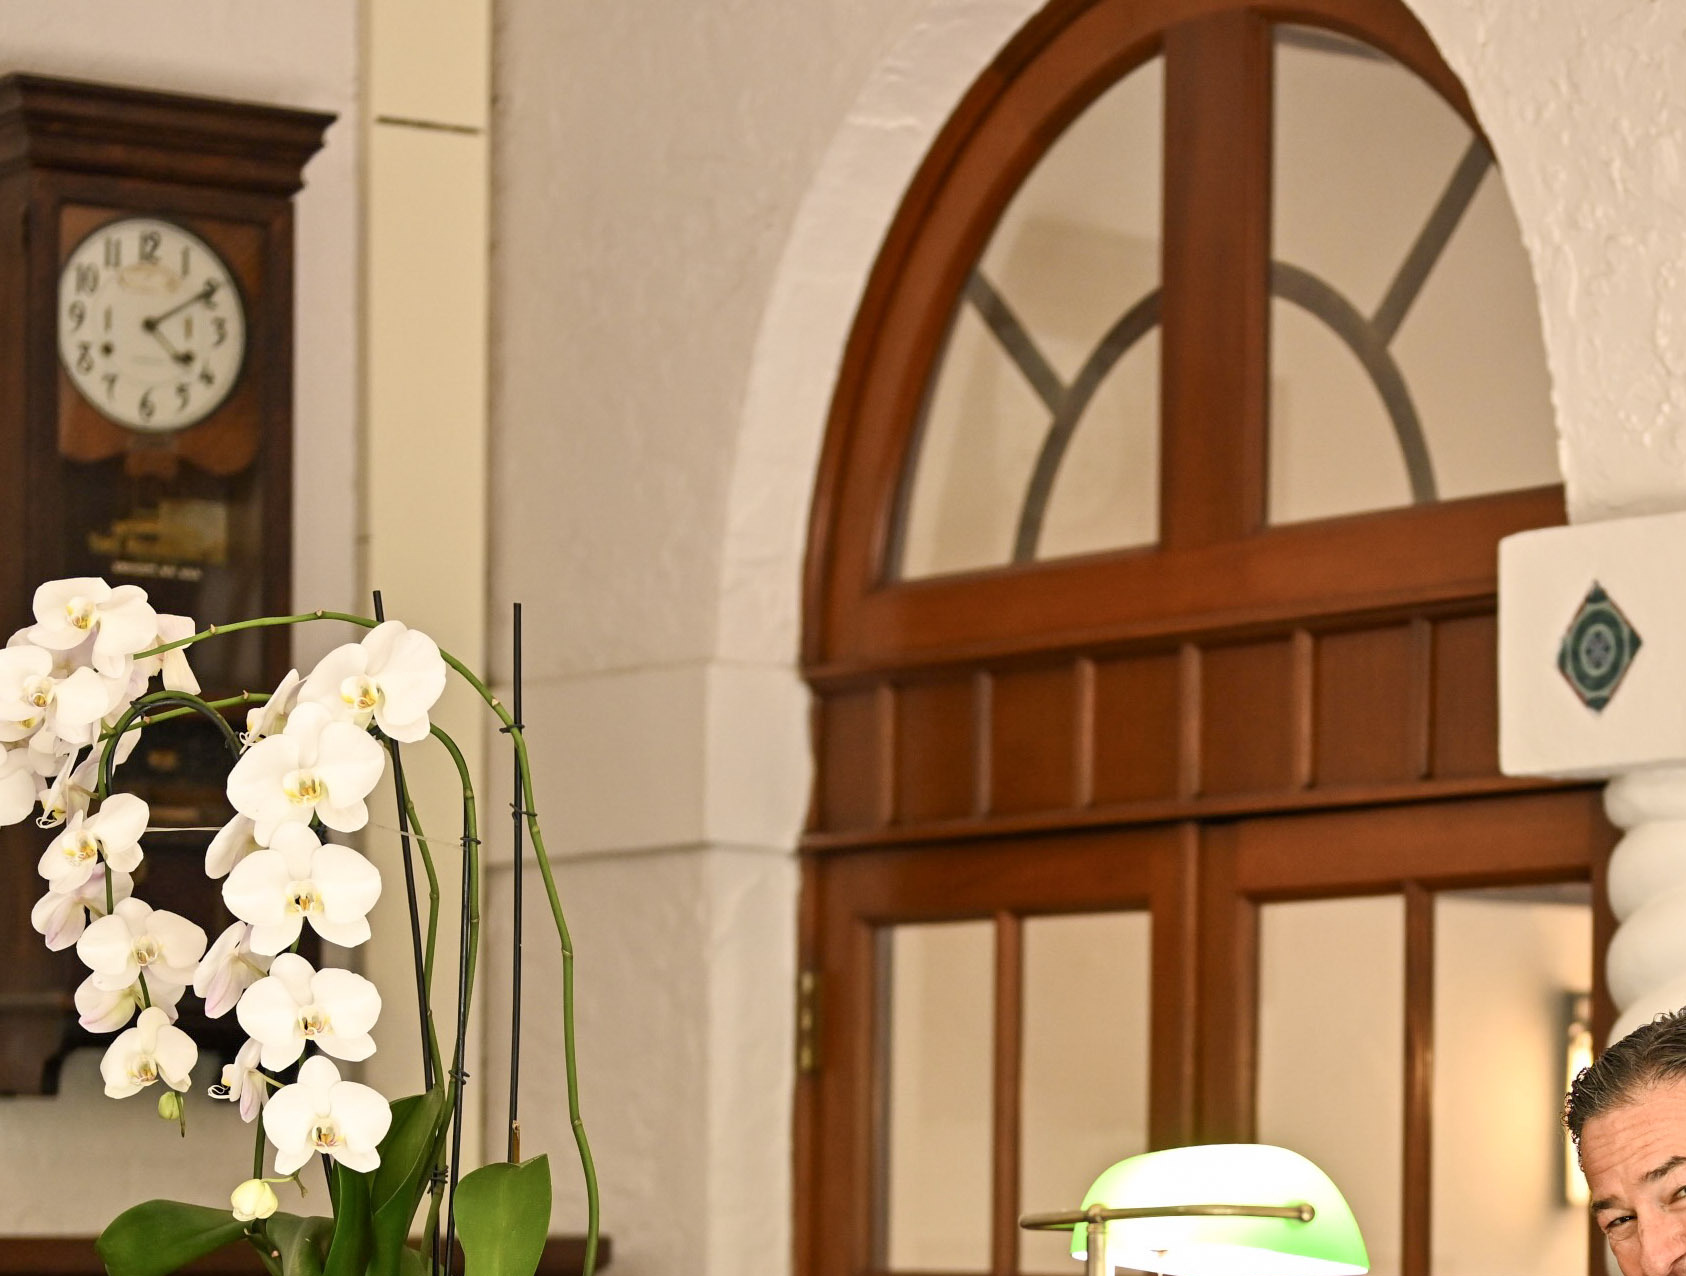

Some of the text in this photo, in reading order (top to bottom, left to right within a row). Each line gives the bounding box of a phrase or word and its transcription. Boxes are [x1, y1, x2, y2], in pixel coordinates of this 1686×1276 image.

[103, 236, 122, 269] 11
[138, 230, 161, 265] 12
[181, 245, 191, 278] 1
[74, 262, 98, 297] 10
[68, 300, 86, 333] 9
[212, 316, 228, 347] 3
[75, 340, 95, 376] 8
[199, 360, 216, 389] 4
[102, 372, 119, 403] 7
[138, 386, 155, 422] 6
[175, 382, 190, 412] 5
